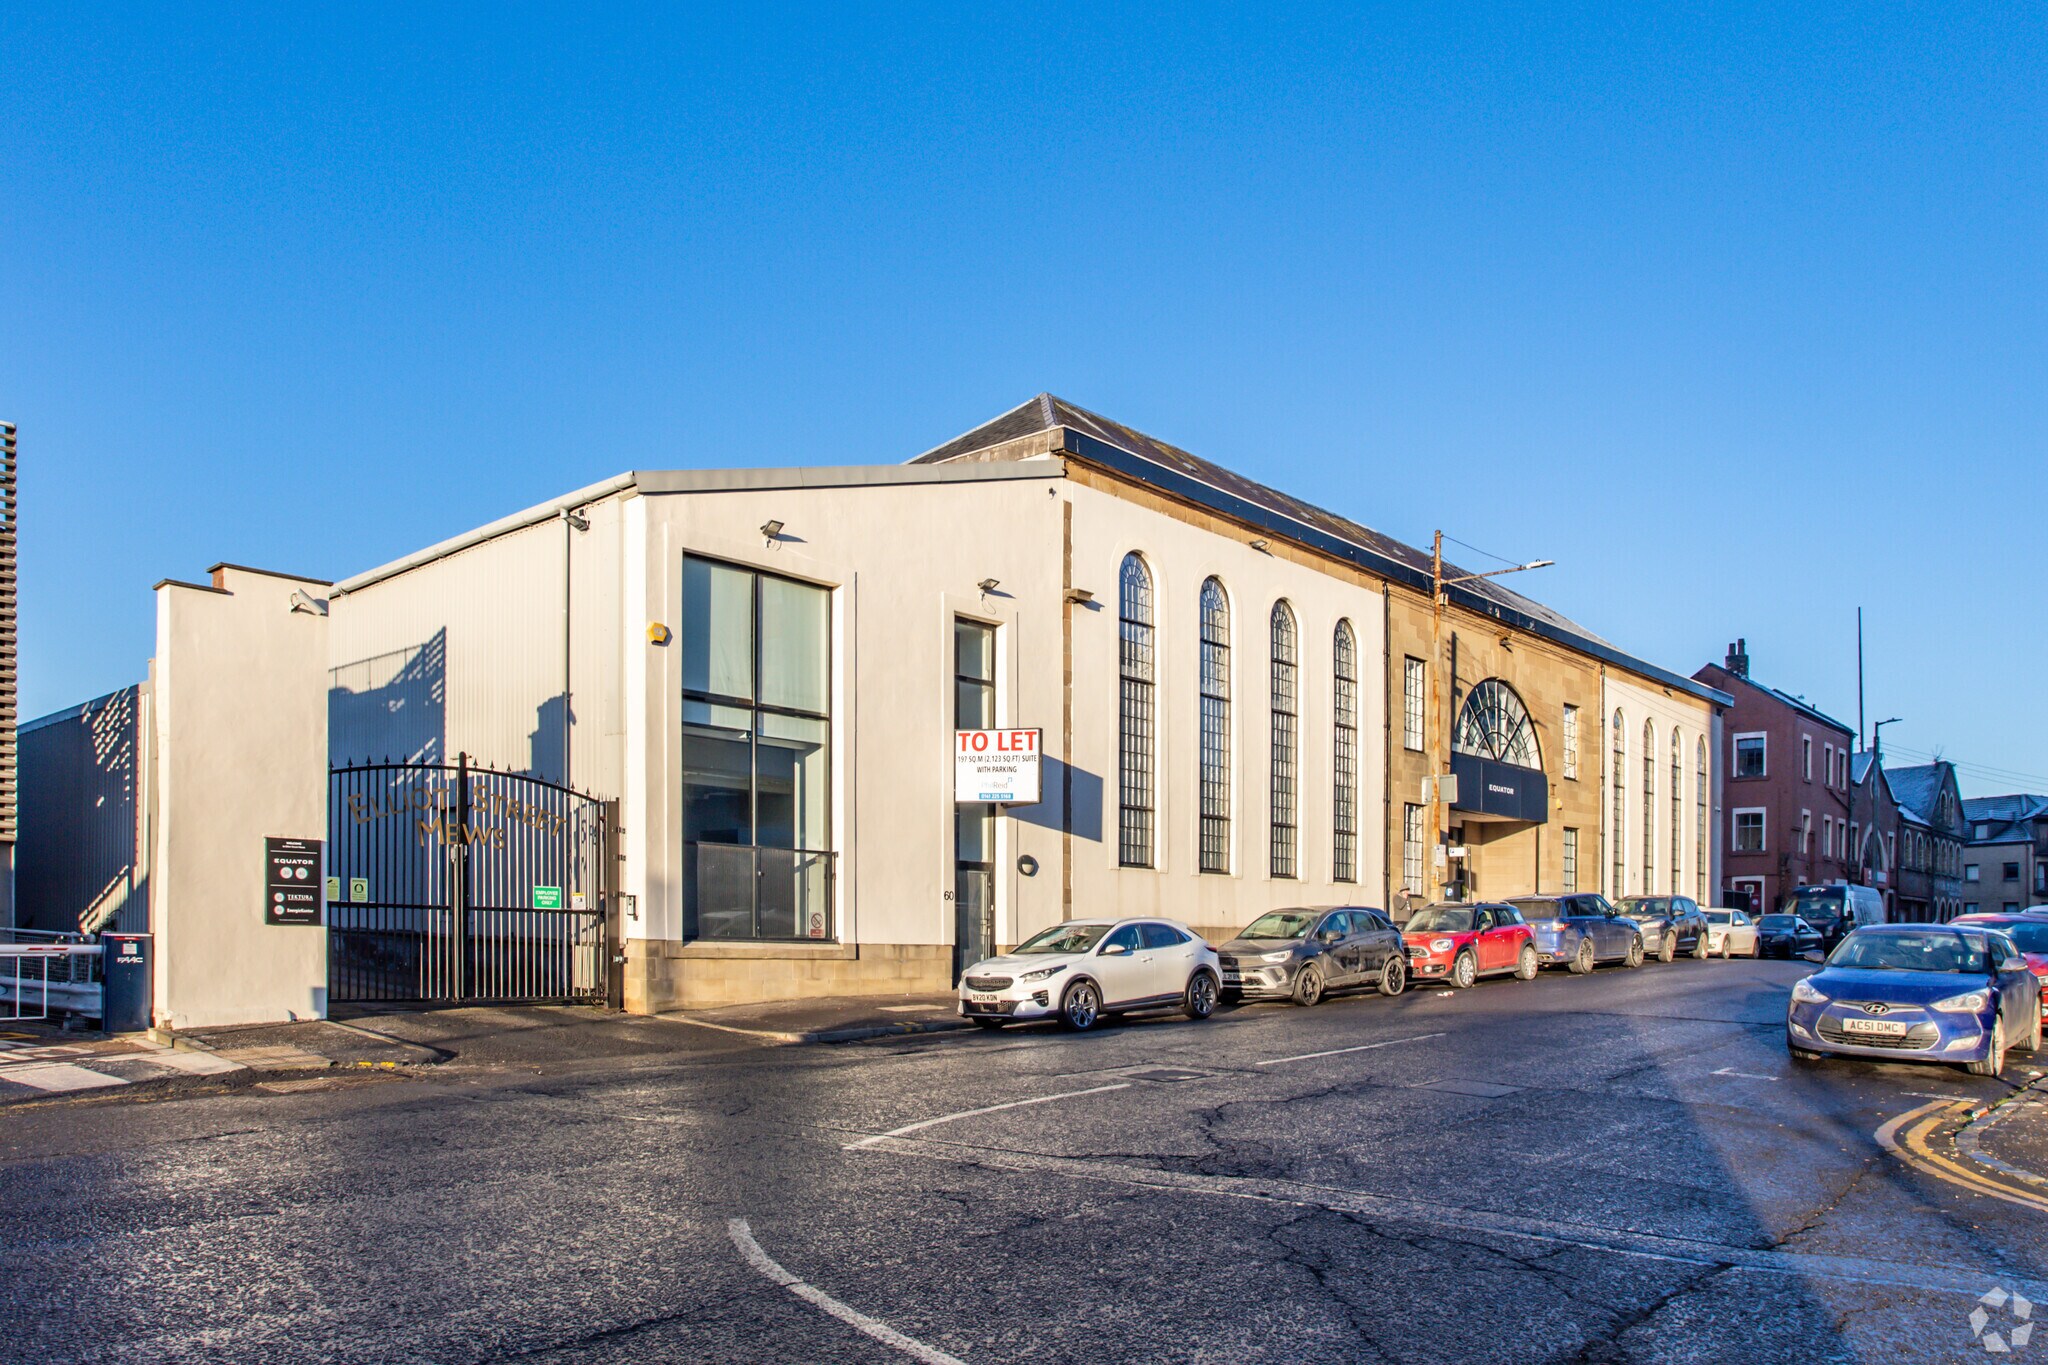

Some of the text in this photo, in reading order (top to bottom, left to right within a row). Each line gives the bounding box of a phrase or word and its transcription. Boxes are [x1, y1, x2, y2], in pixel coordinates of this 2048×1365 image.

[958, 731, 1037, 752] TO LET
[958, 755, 967, 763] 197
[1022, 754, 1037, 762] SUITE
[992, 765, 1017, 773] PARKING
[1488, 783, 1514, 795] EQUATOR
[347, 784, 567, 837] ELLIOT STREET
[416, 816, 505, 849] MEWS
[944, 890, 954, 901] 60
[1850, 1020, 1899, 1033] AC51 DMC
